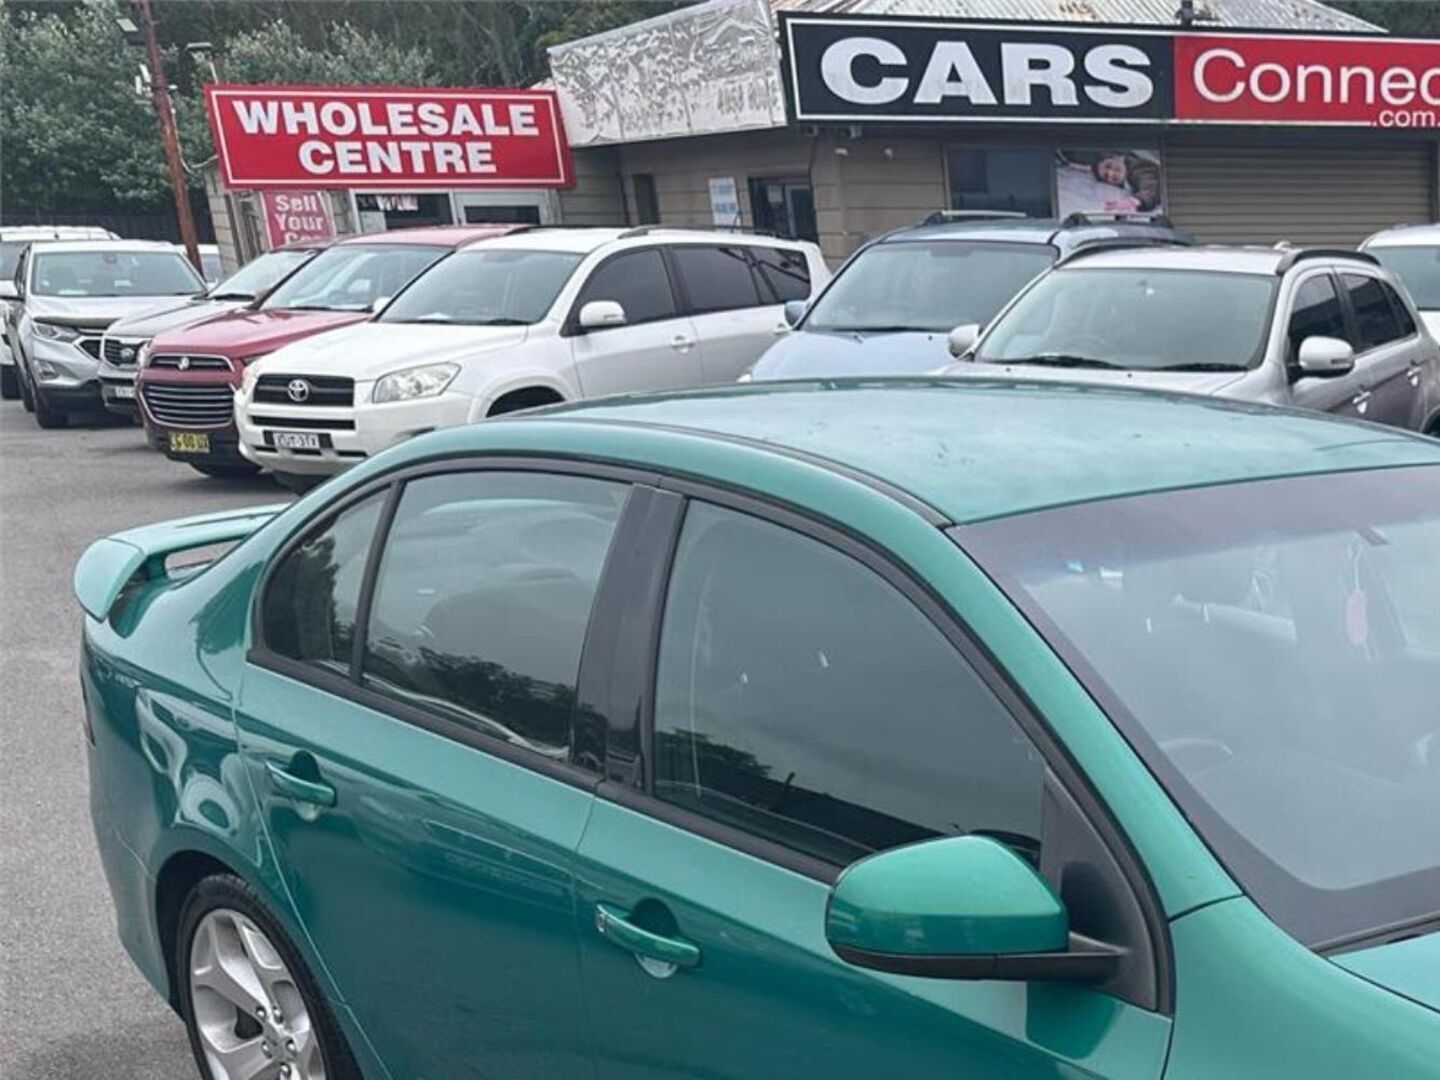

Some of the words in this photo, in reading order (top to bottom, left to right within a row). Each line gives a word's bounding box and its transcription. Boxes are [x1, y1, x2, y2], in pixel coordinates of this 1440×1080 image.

[820, 37, 1155, 108] CARS
[231, 99, 540, 136] WHOLESALE
[298, 140, 497, 174] CENTRE
[275, 194, 318, 212] Sell
[274, 213, 324, 231] Your
